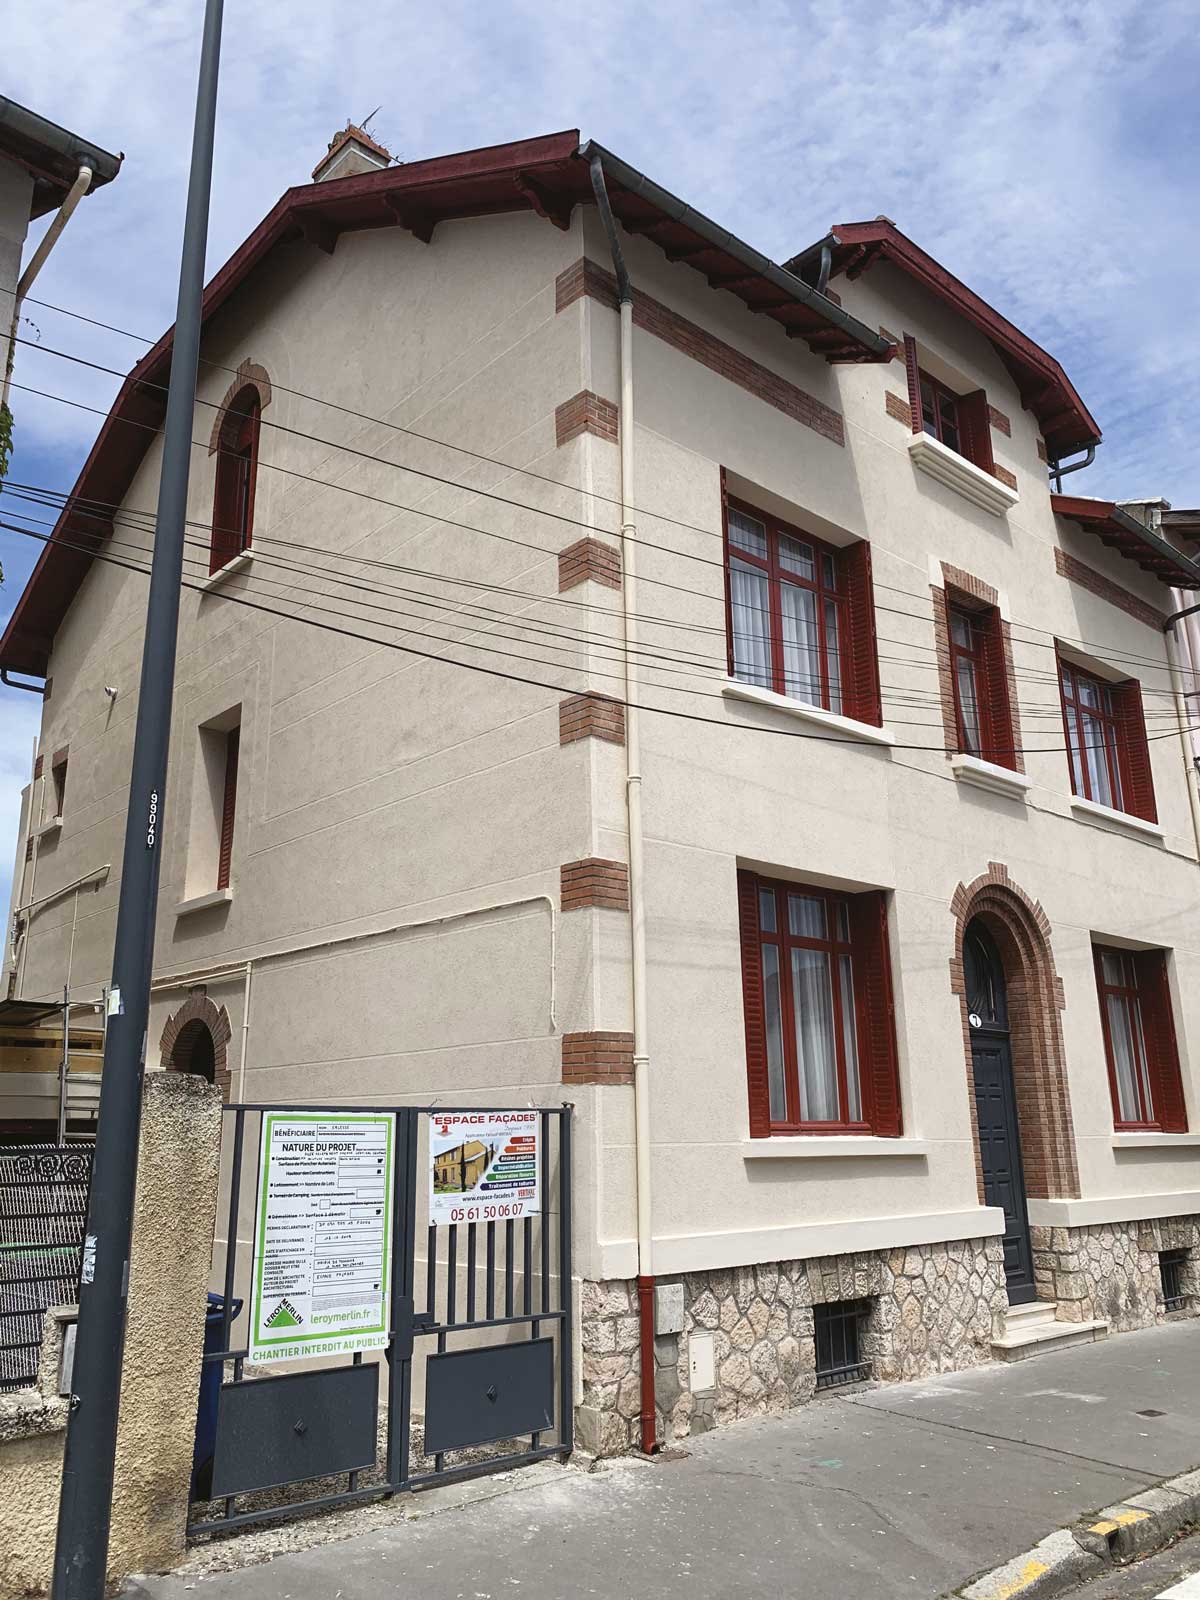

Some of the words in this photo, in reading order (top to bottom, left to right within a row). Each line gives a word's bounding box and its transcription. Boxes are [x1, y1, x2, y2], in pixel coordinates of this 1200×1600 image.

[147, 793, 158, 845] 99040
[435, 1116, 485, 1125] ESPACE
[489, 1114, 535, 1124] FAÇADES
[274, 1128, 316, 1137] BÉNÉFICIAIRE
[282, 1143, 315, 1152] NATURE
[316, 1143, 327, 1152] DU
[328, 1143, 357, 1152] PROJET
[462, 1192, 515, 1203] www.espace-facades.fr
[451, 1209, 464, 1221] 05
[467, 1207, 479, 1220] 61
[484, 1205, 496, 1218] 50
[499, 1204, 510, 1217] 06
[512, 1203, 523, 1216] 07
[263, 1303, 283, 1328] LEROY
[281, 1298, 304, 1325] MERLIN
[310, 1309, 371, 1325] leroymerlin.fr
[252, 1346, 300, 1361] CHANTIER
[301, 1342, 342, 1355] INTERDIT
[343, 1340, 355, 1349] AU
[356, 1337, 386, 1348] PUBLIC
